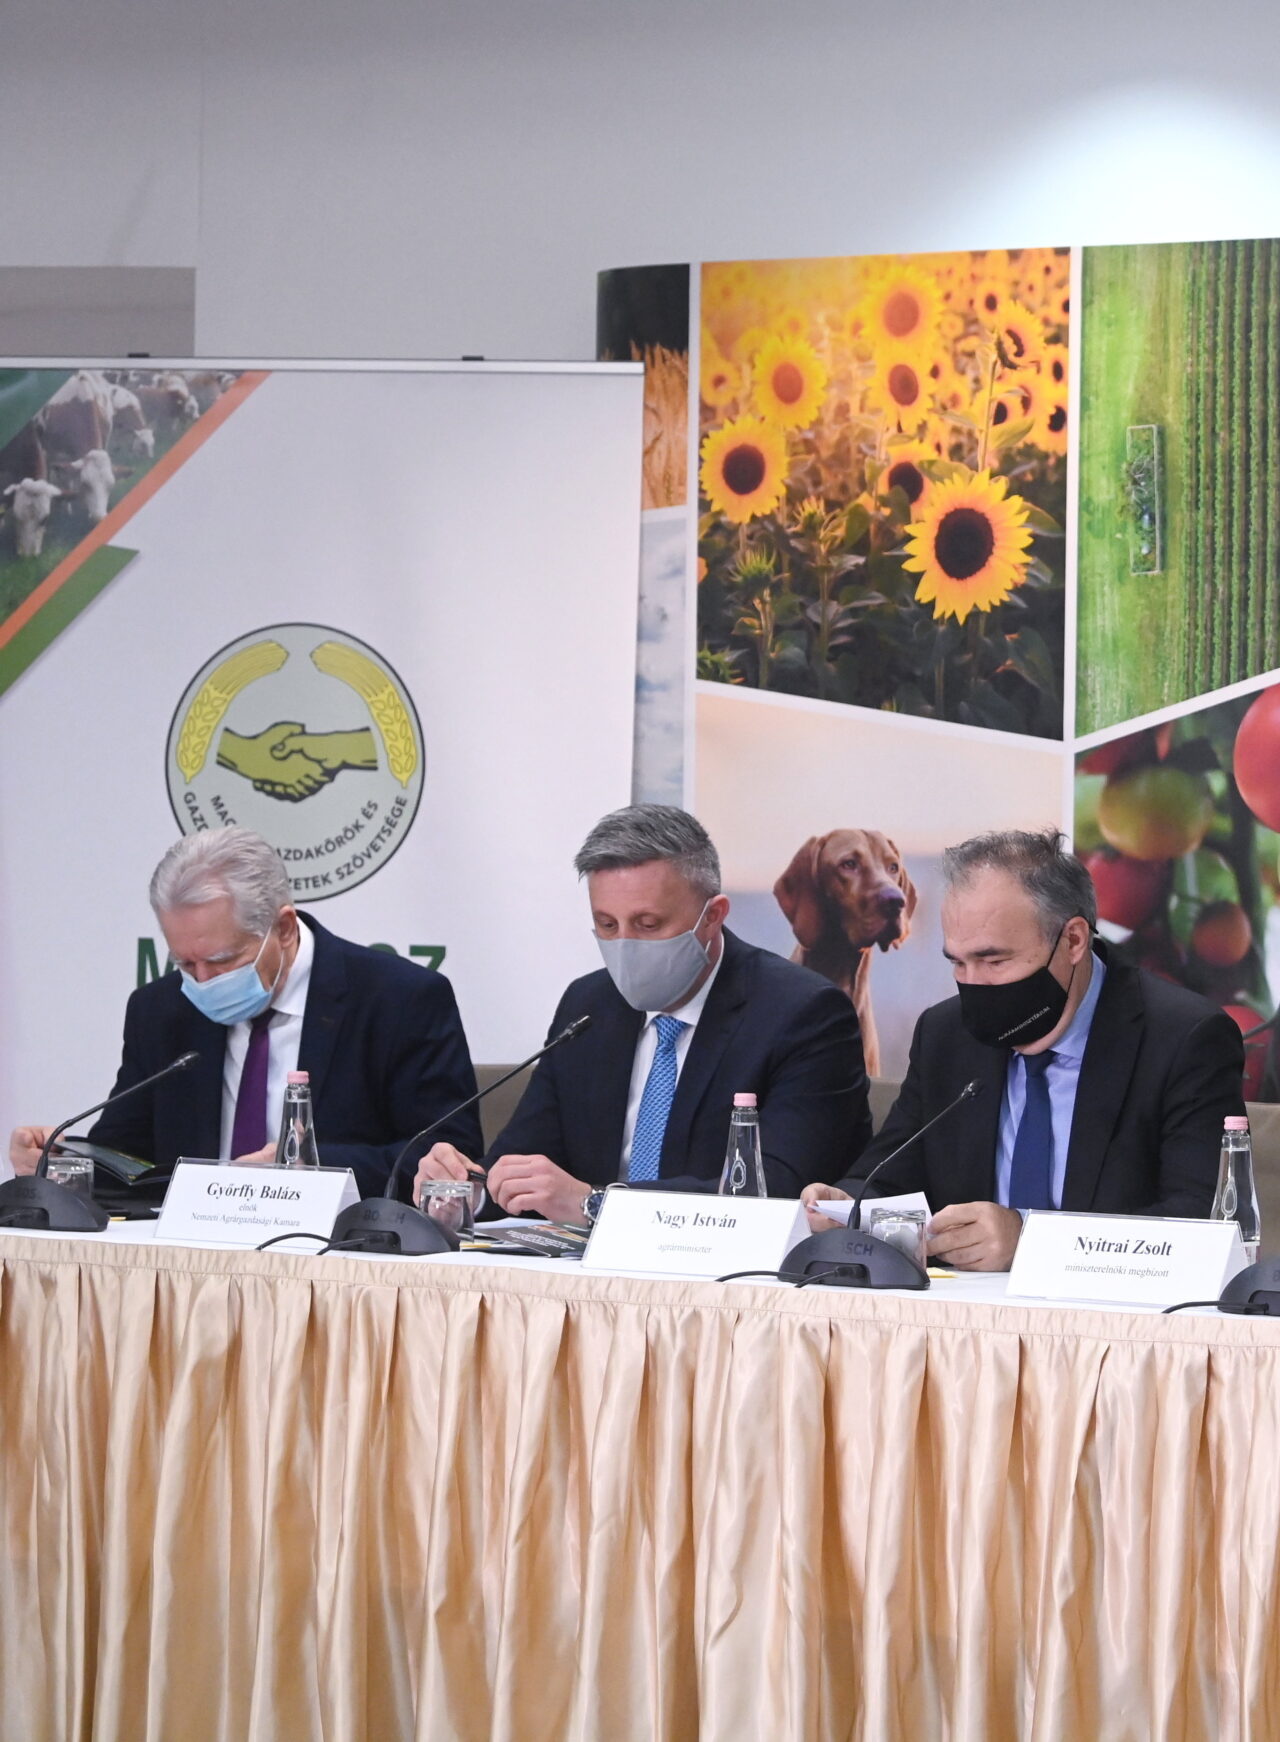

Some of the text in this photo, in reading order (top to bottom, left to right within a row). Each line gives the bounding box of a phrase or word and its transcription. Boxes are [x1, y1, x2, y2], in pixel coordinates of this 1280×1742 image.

[361, 799, 380, 820] ÉS
[335, 795, 408, 881] SZÖVETSÉGE
[206, 1181, 301, 1201] Győrffy Balázs
[653, 1210, 737, 1229] Nagy István
[1074, 1236, 1173, 1256] Nyitrai Zsolt
